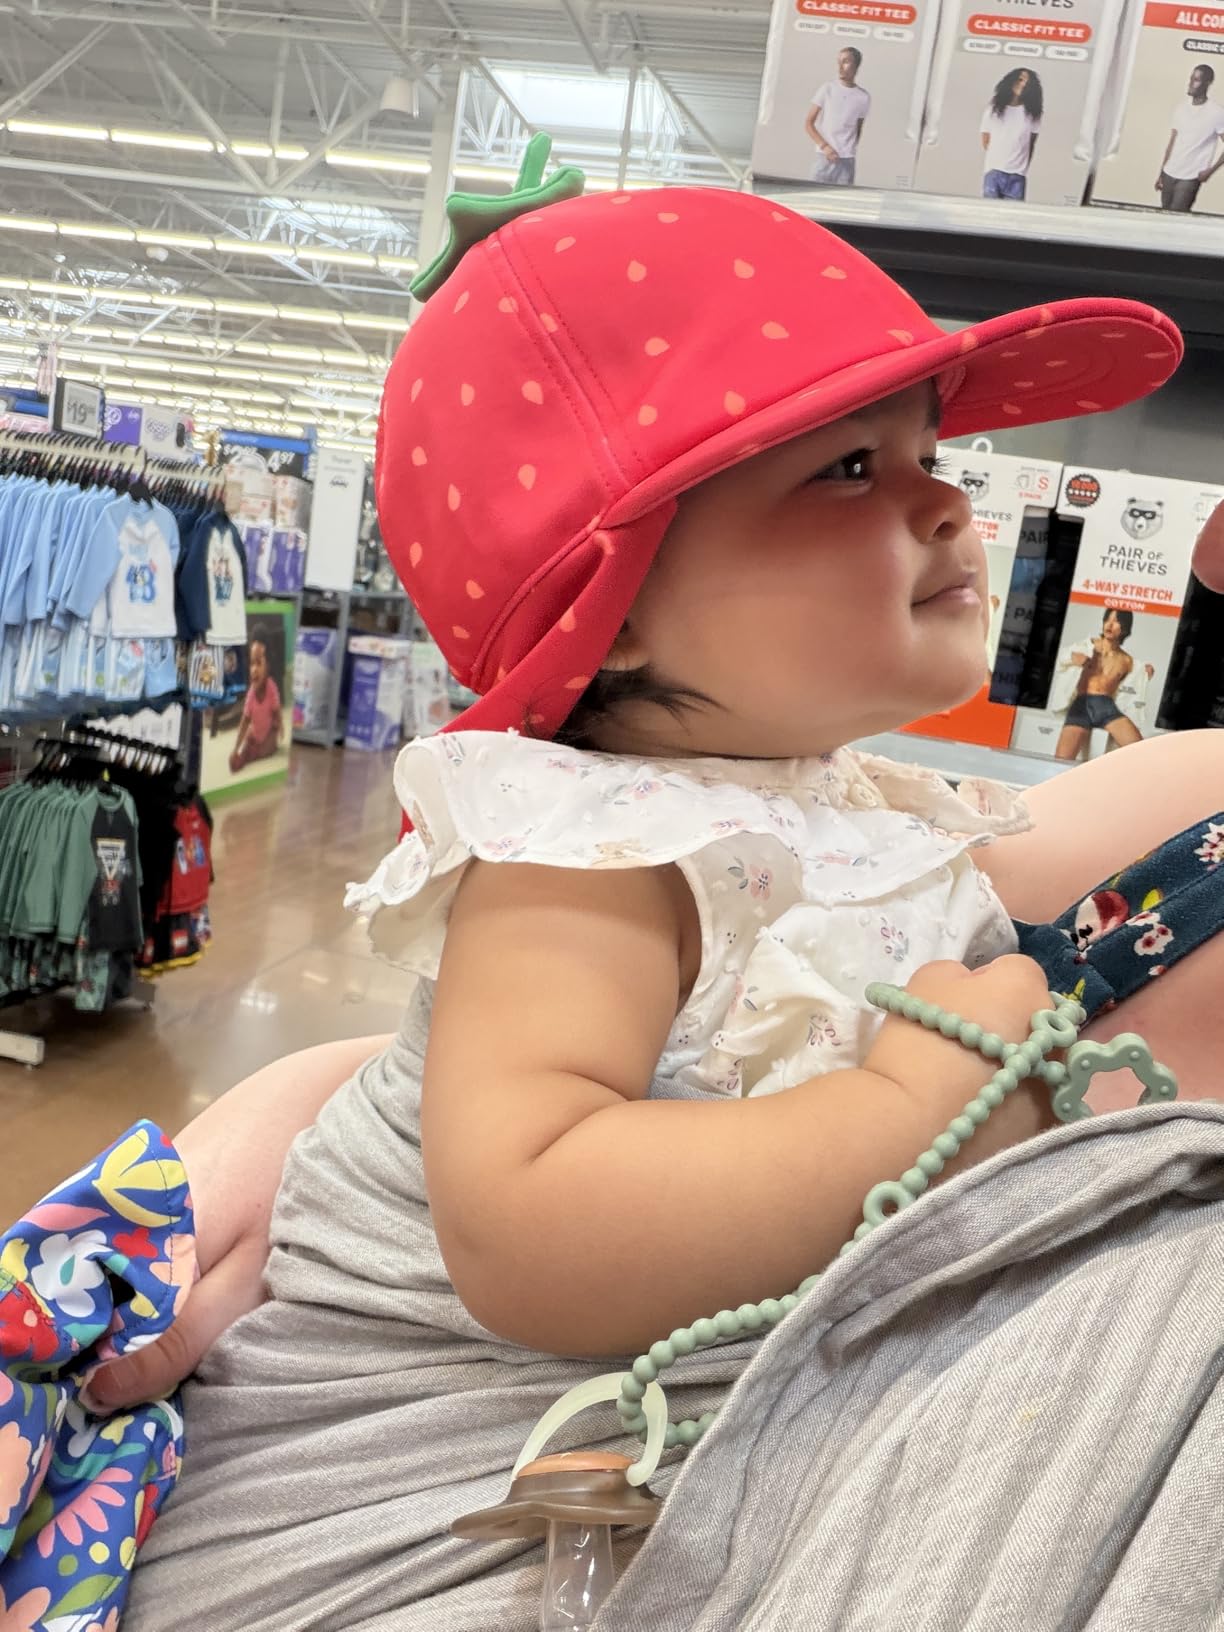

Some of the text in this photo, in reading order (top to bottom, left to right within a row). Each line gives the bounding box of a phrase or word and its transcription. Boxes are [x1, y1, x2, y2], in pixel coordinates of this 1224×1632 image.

[802, 0, 910, 20] CLASSIC FIT TEE
[1176, 11, 1200, 26] ALL
[974, 19, 1085, 38] CLASSIC FIT TEE
[1038, 476, 1049, 490] S
[972, 509, 1013, 521] HIEVES
[1108, 544, 1164, 561] PAIR OF
[1100, 556, 1168, 576] THIEVES
[1083, 579, 1173, 601] 4-WAY STRETCH
[1104, 598, 1145, 610] COTTON
